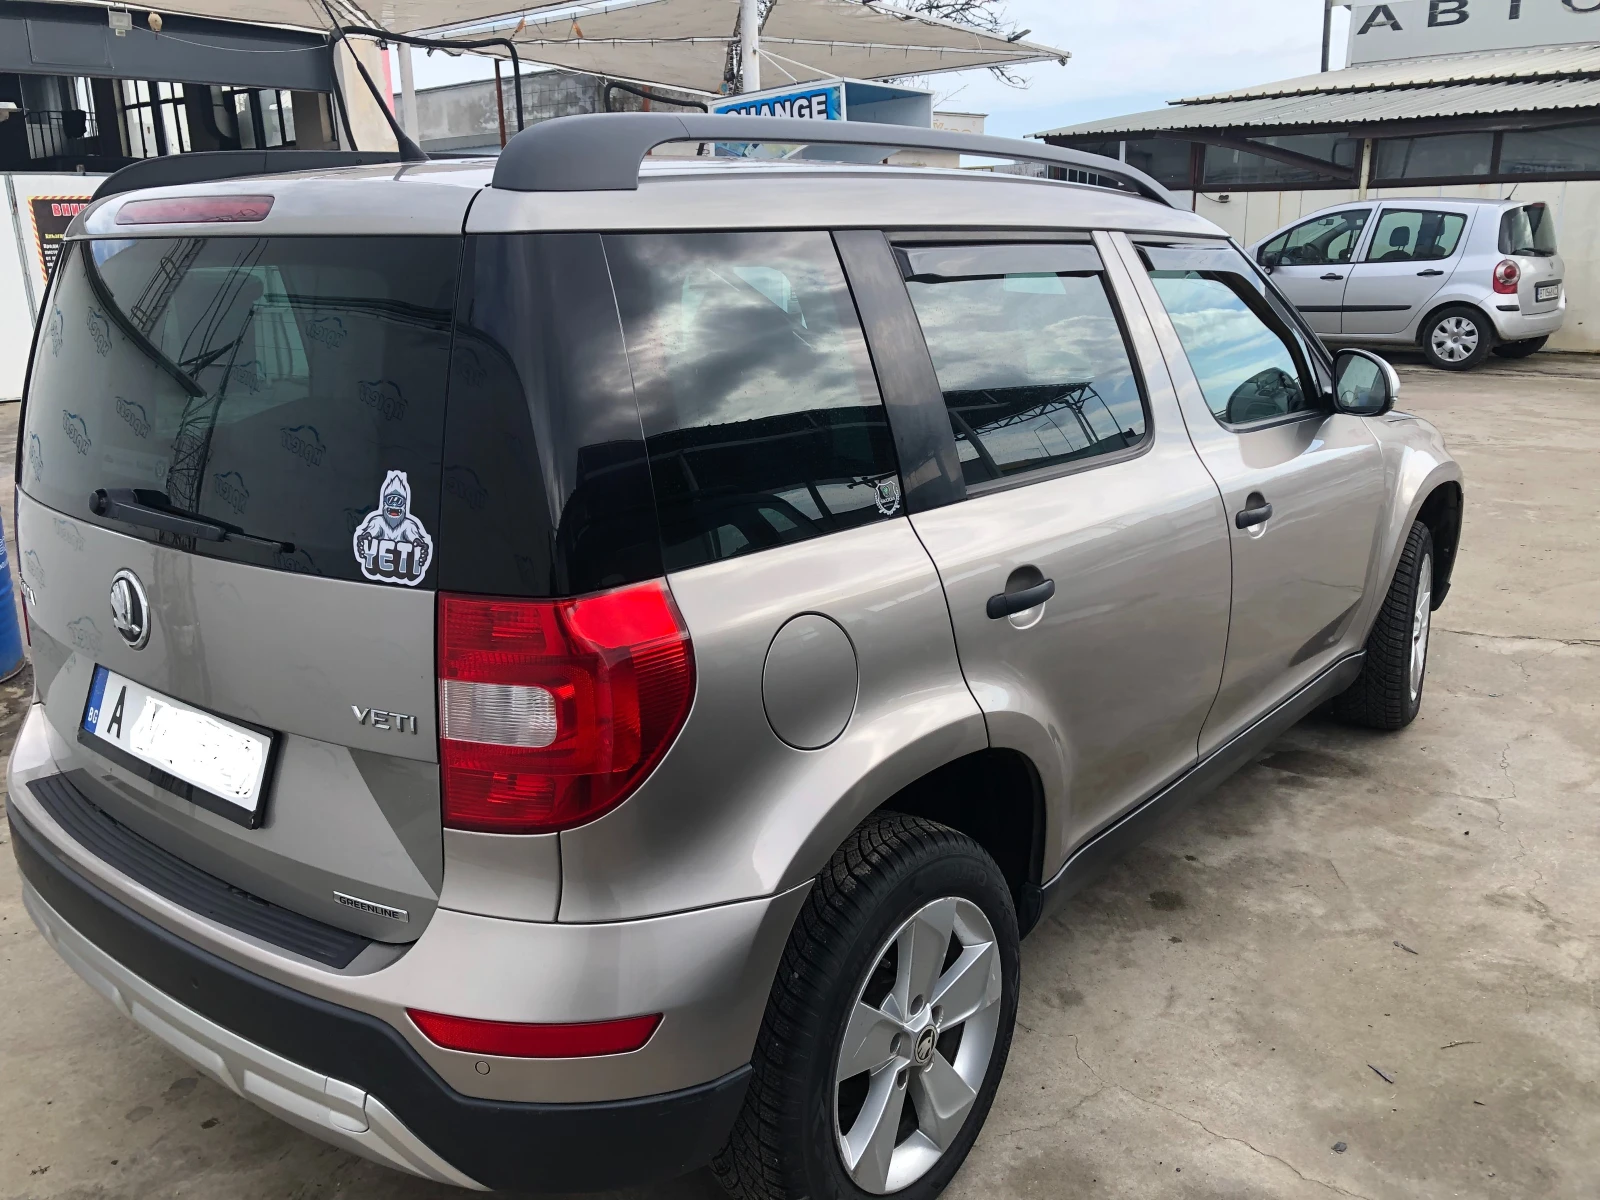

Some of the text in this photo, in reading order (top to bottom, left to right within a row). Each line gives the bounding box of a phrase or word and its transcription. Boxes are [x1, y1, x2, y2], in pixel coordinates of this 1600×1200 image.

[363, 538, 422, 575] YETI
[88, 685, 127, 740] BG A
[350, 703, 418, 736] YETI
[339, 895, 400, 919] GREENLINE
